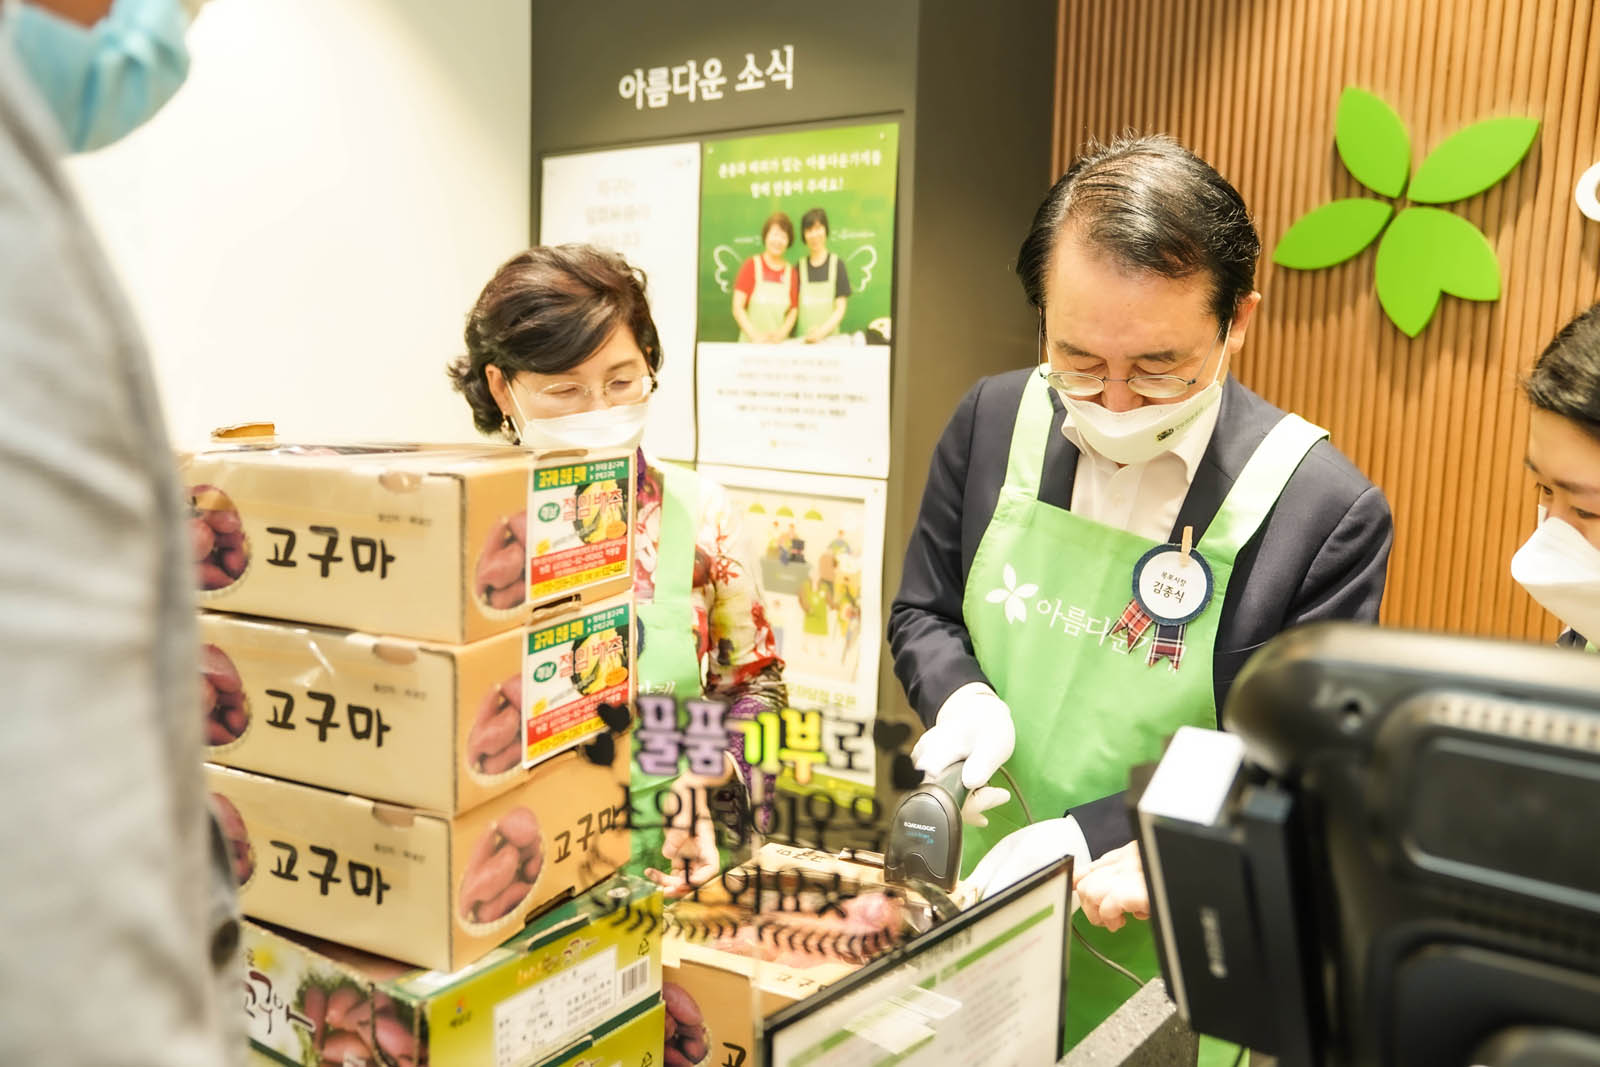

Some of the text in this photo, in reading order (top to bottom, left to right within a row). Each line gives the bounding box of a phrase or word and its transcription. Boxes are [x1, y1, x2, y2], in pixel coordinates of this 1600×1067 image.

[618, 44, 796, 110] 아름다운 소식
[562, 487, 624, 522] 절임배추
[266, 526, 395, 580] 고구마
[1153, 580, 1185, 604] 김종식
[558, 635, 624, 679] 절임배추
[265, 689, 391, 748] 고구마
[269, 840, 392, 904] 고구마
